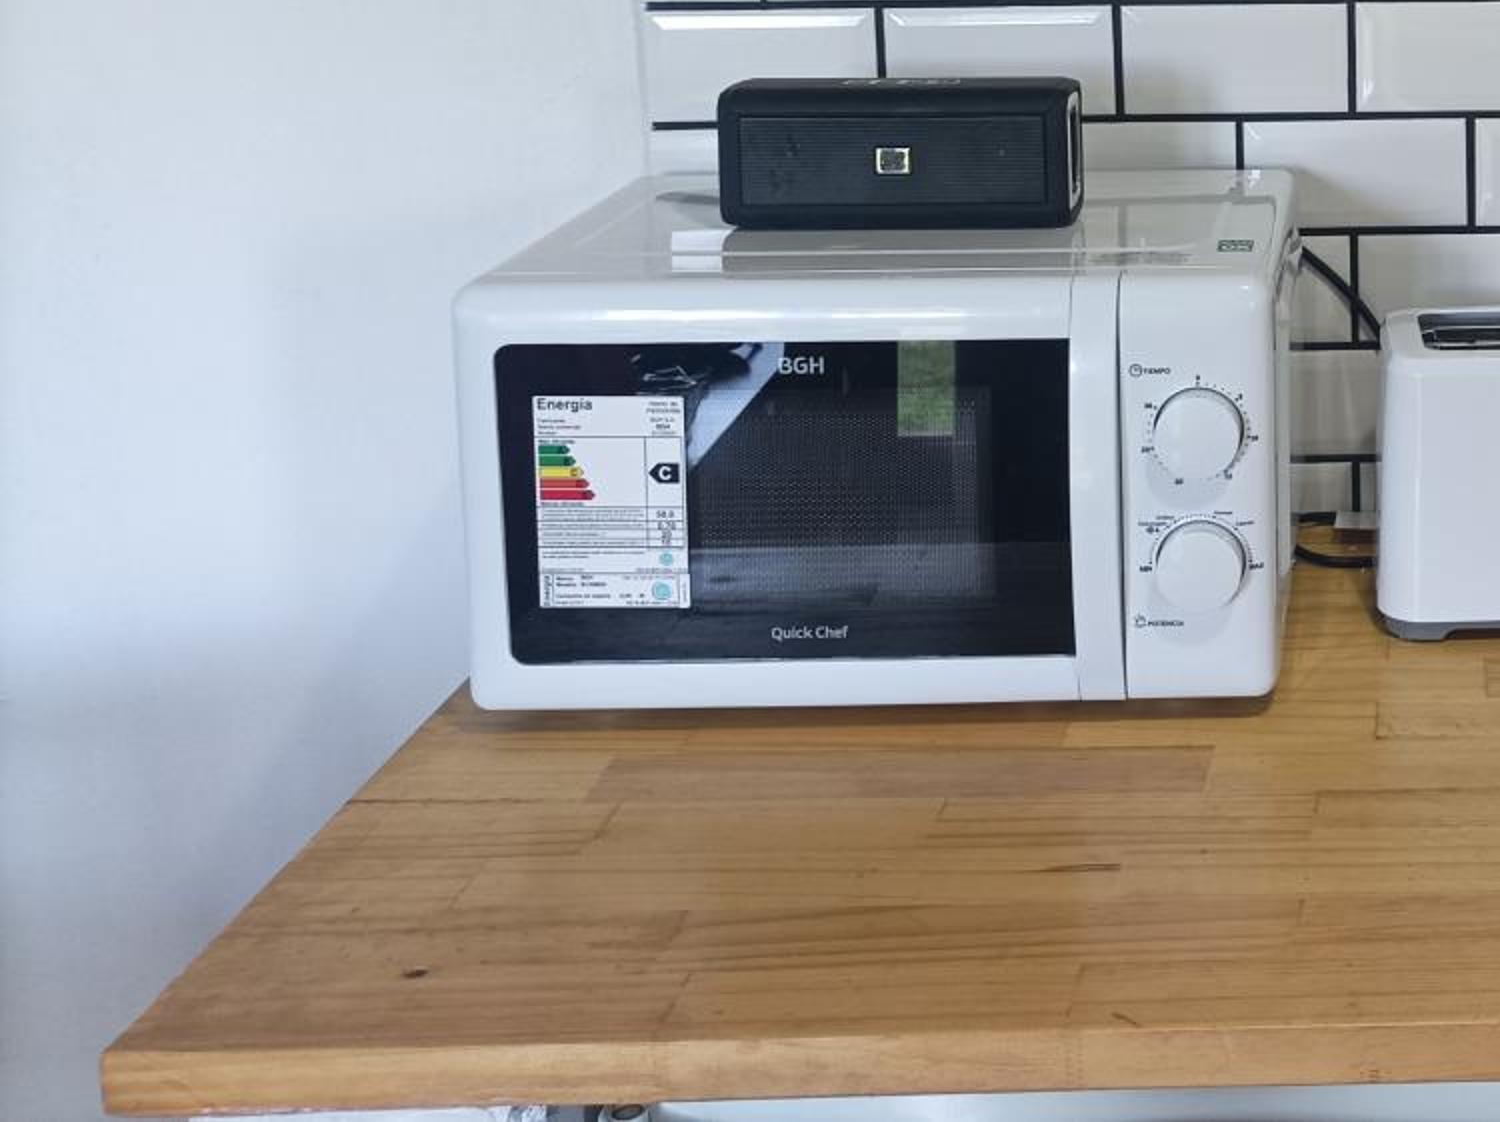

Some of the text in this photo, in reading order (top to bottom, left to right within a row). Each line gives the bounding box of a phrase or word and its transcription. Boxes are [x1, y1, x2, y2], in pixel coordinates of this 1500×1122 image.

[778, 357, 824, 374] BGH
[658, 465, 671, 480] C
[771, 625, 848, 642] Quick Chef
